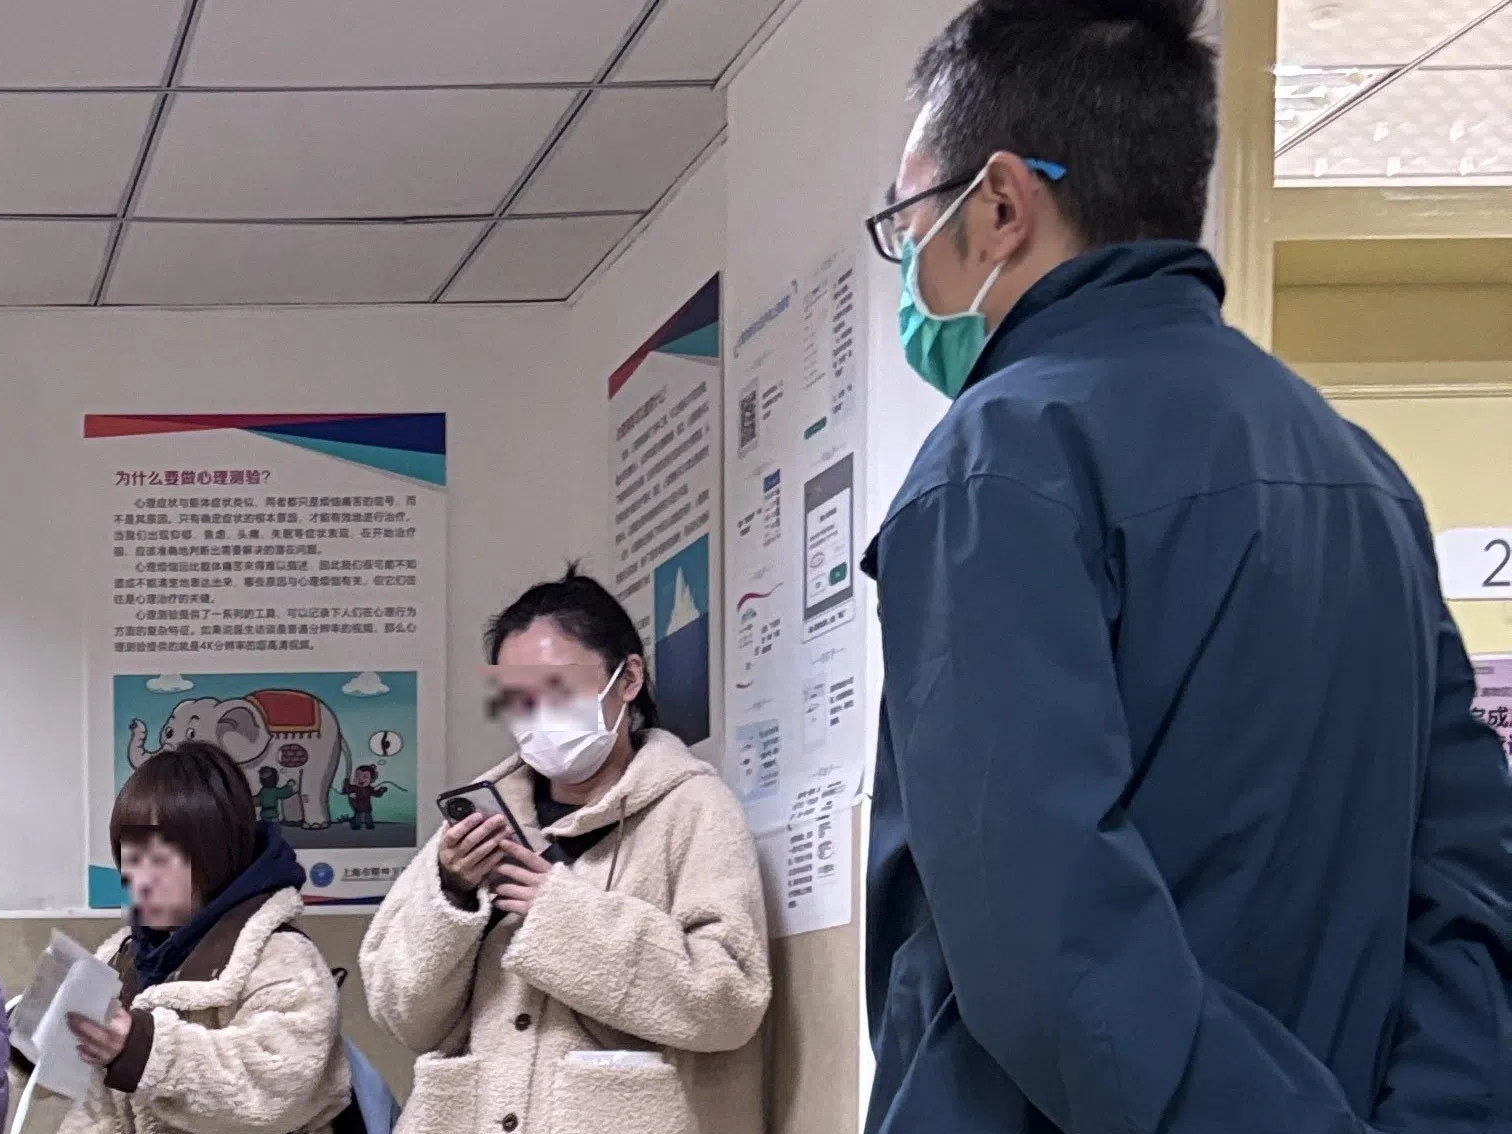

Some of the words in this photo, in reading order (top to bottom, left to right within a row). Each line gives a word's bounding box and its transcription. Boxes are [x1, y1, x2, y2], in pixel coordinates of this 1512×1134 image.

[115, 469, 271, 486] 为什么要做心理测验?
